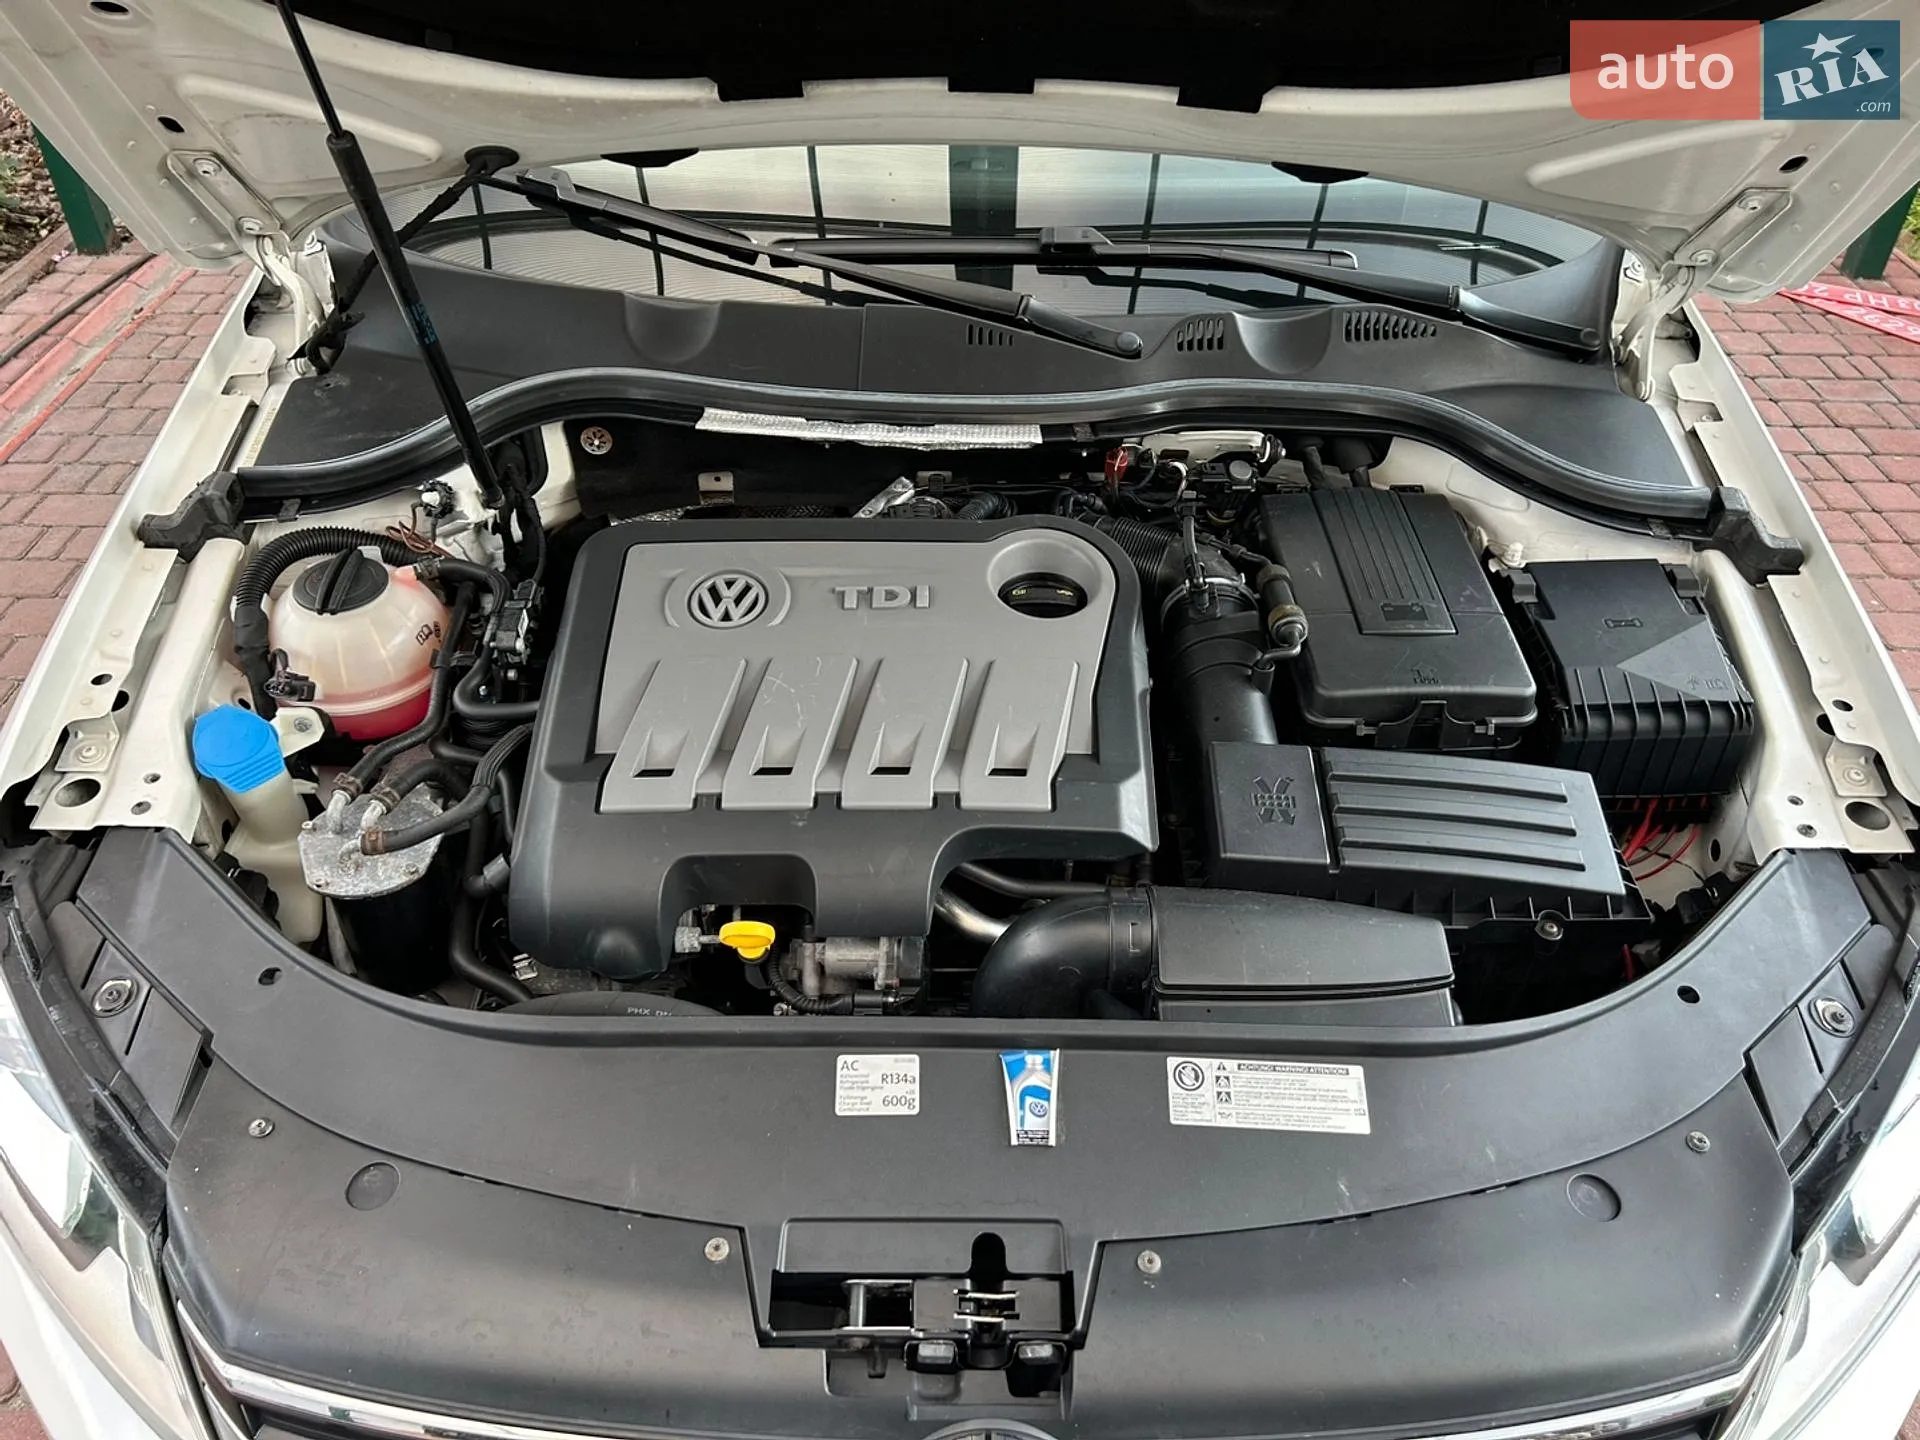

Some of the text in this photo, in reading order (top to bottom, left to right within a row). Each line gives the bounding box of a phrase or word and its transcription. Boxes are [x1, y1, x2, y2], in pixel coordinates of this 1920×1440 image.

[831, 585, 931, 611] TDI
[840, 1060, 860, 1073] AC
[881, 1073, 917, 1085] R134a
[882, 1095, 917, 1111] 600g
